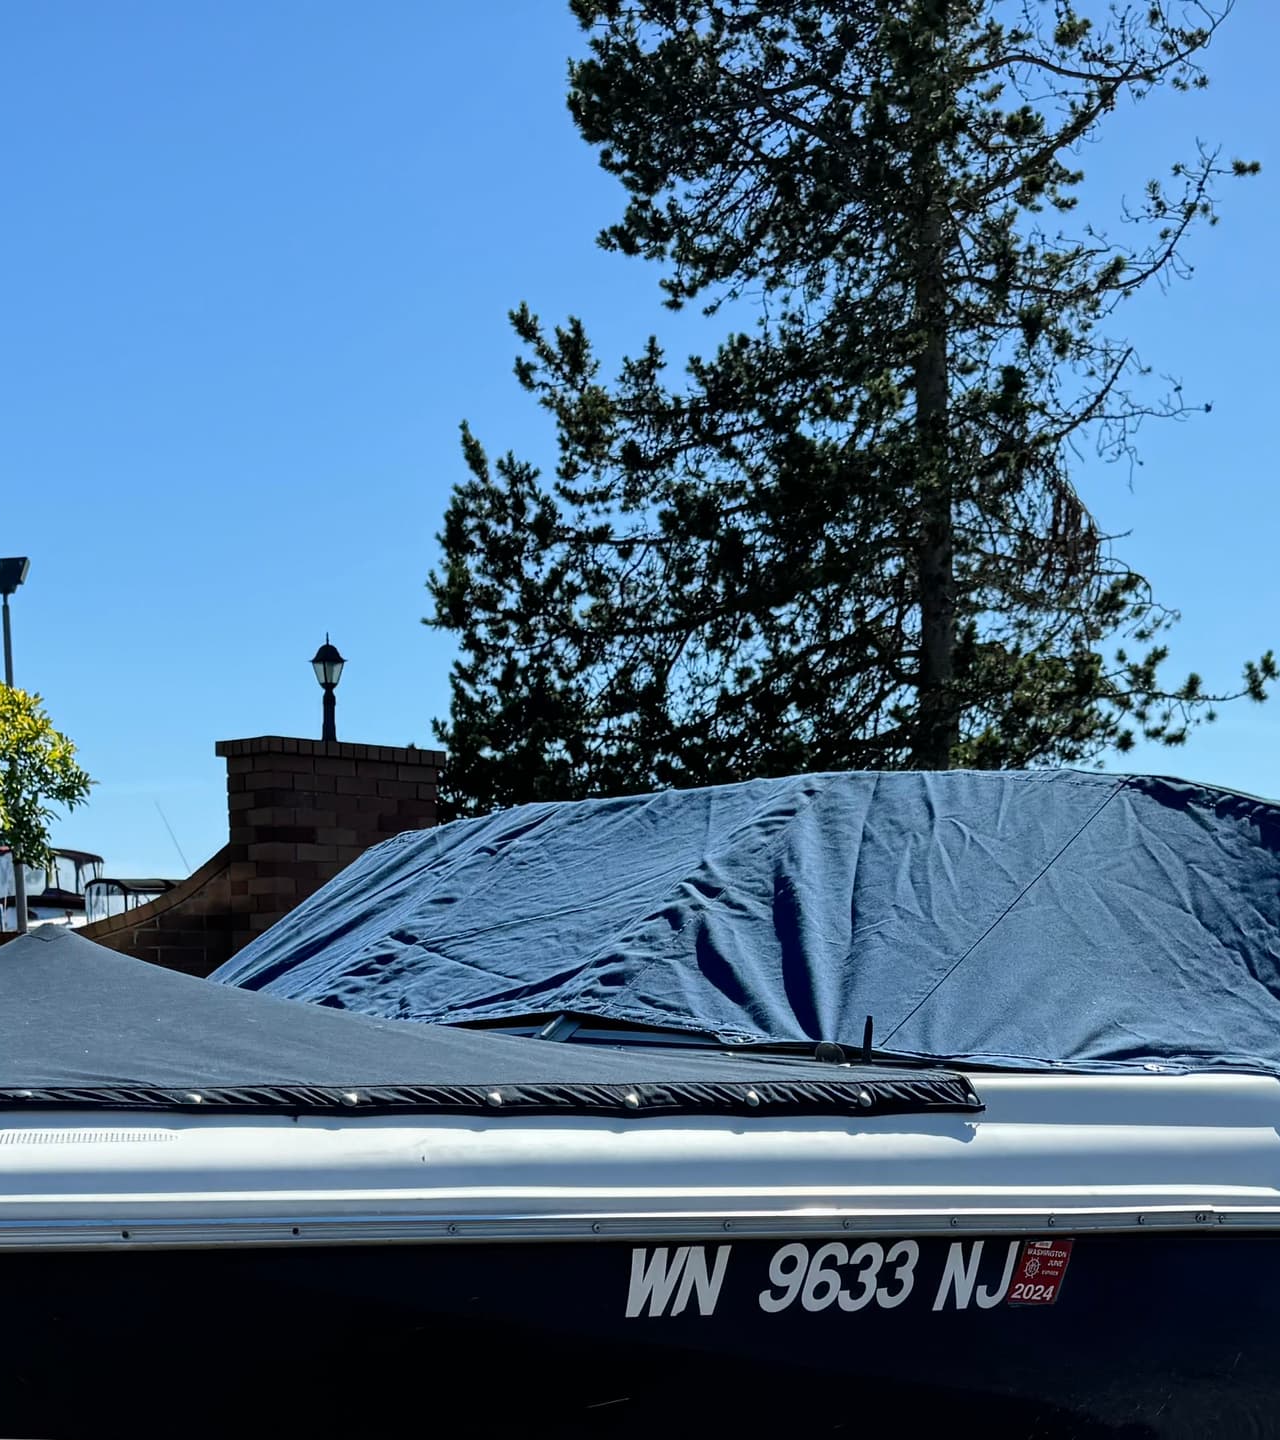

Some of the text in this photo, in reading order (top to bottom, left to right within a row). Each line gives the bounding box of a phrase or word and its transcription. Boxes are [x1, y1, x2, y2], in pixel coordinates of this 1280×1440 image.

[1027, 1248, 1067, 1258] WASHINGTON
[625, 1240, 1020, 1318] WN 9633 NJ
[1011, 1283, 1055, 1301] 2024
